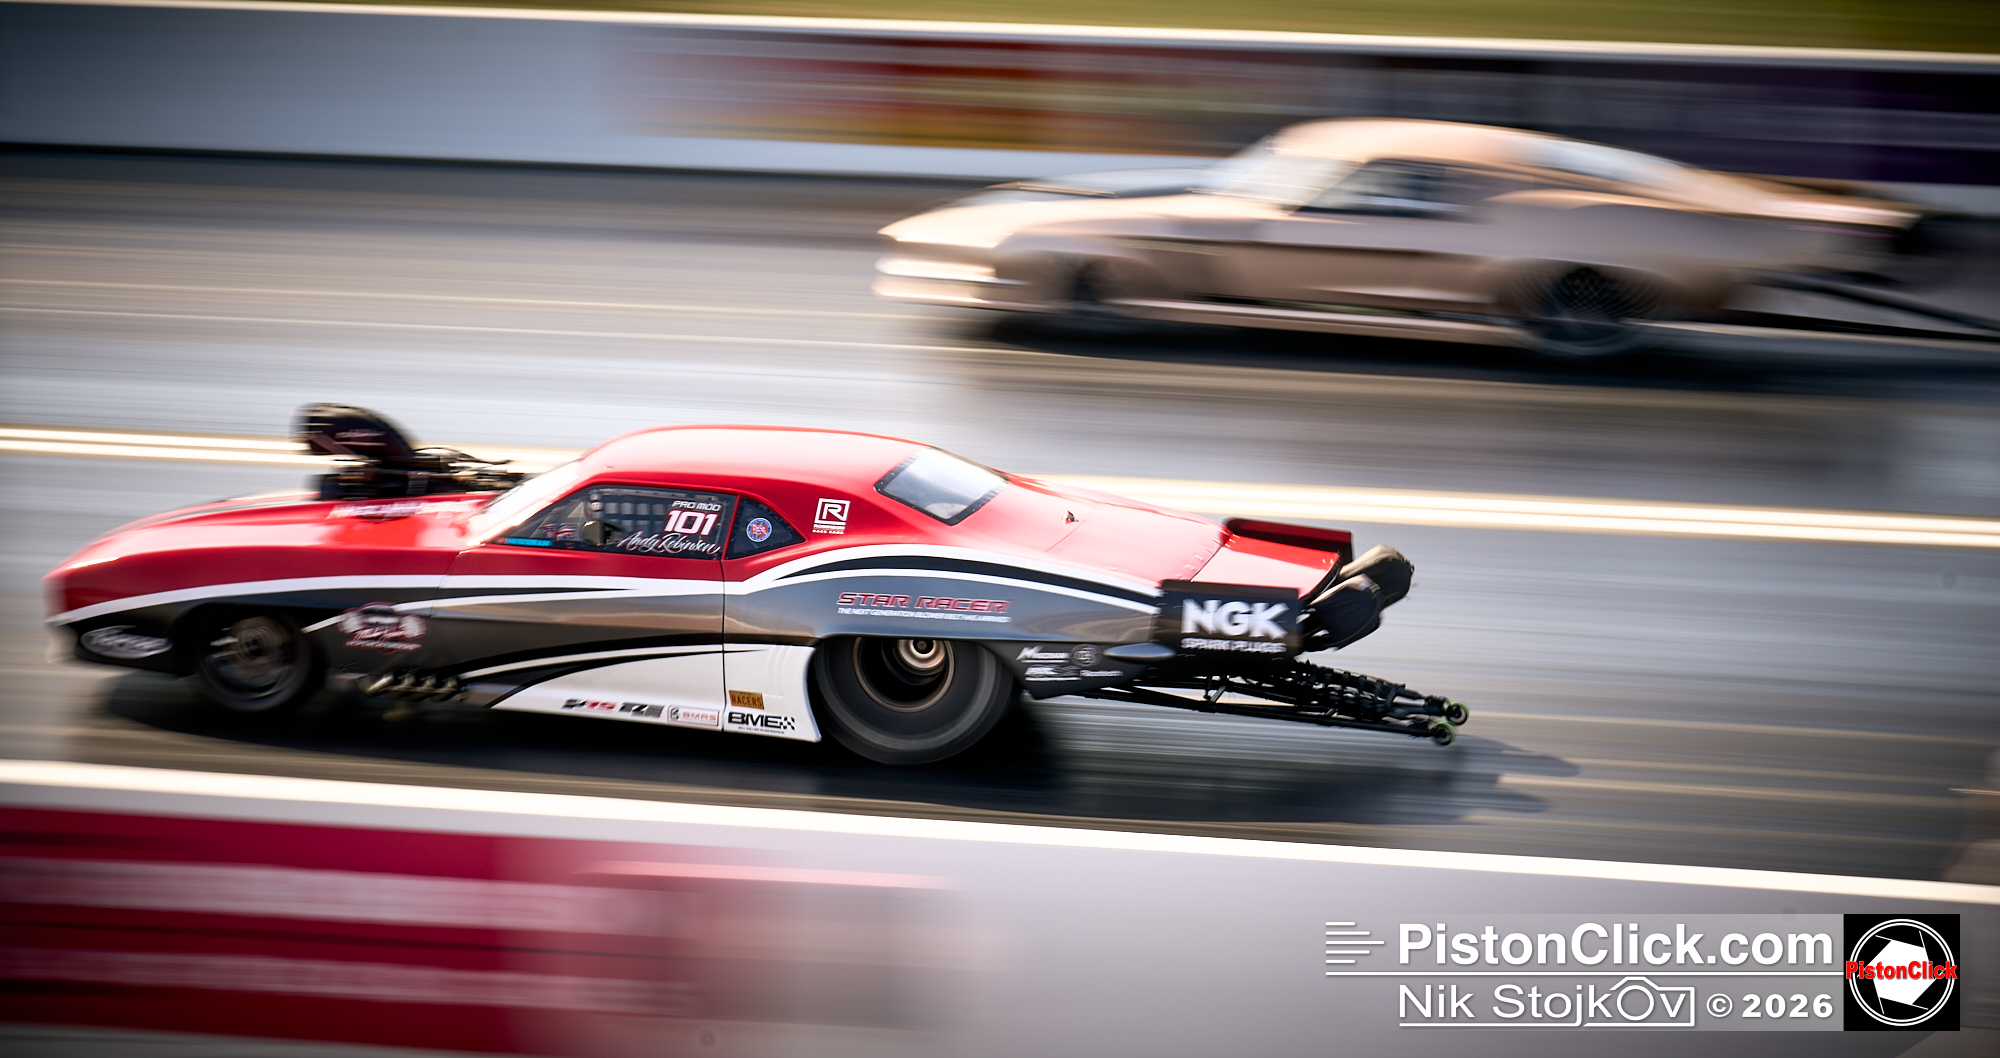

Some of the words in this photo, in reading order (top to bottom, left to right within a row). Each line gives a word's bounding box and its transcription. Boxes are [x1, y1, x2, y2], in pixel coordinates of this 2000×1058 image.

[672, 500, 696, 509] PRO
[696, 502, 722, 511] MOD
[664, 509, 719, 536] 101
[616, 530, 665, 553] Andy
[658, 532, 722, 555] Robinson
[836, 592, 912, 609] STAR
[914, 595, 1010, 613] RACER
[837, 607, 852, 615] THE
[851, 608, 871, 616] NEXT
[1181, 599, 1289, 640] NGK
[1181, 637, 1230, 651] SPARK
[1231, 640, 1287, 654] PLUGS
[731, 694, 762, 707] RACERS
[728, 711, 782, 728] BME
